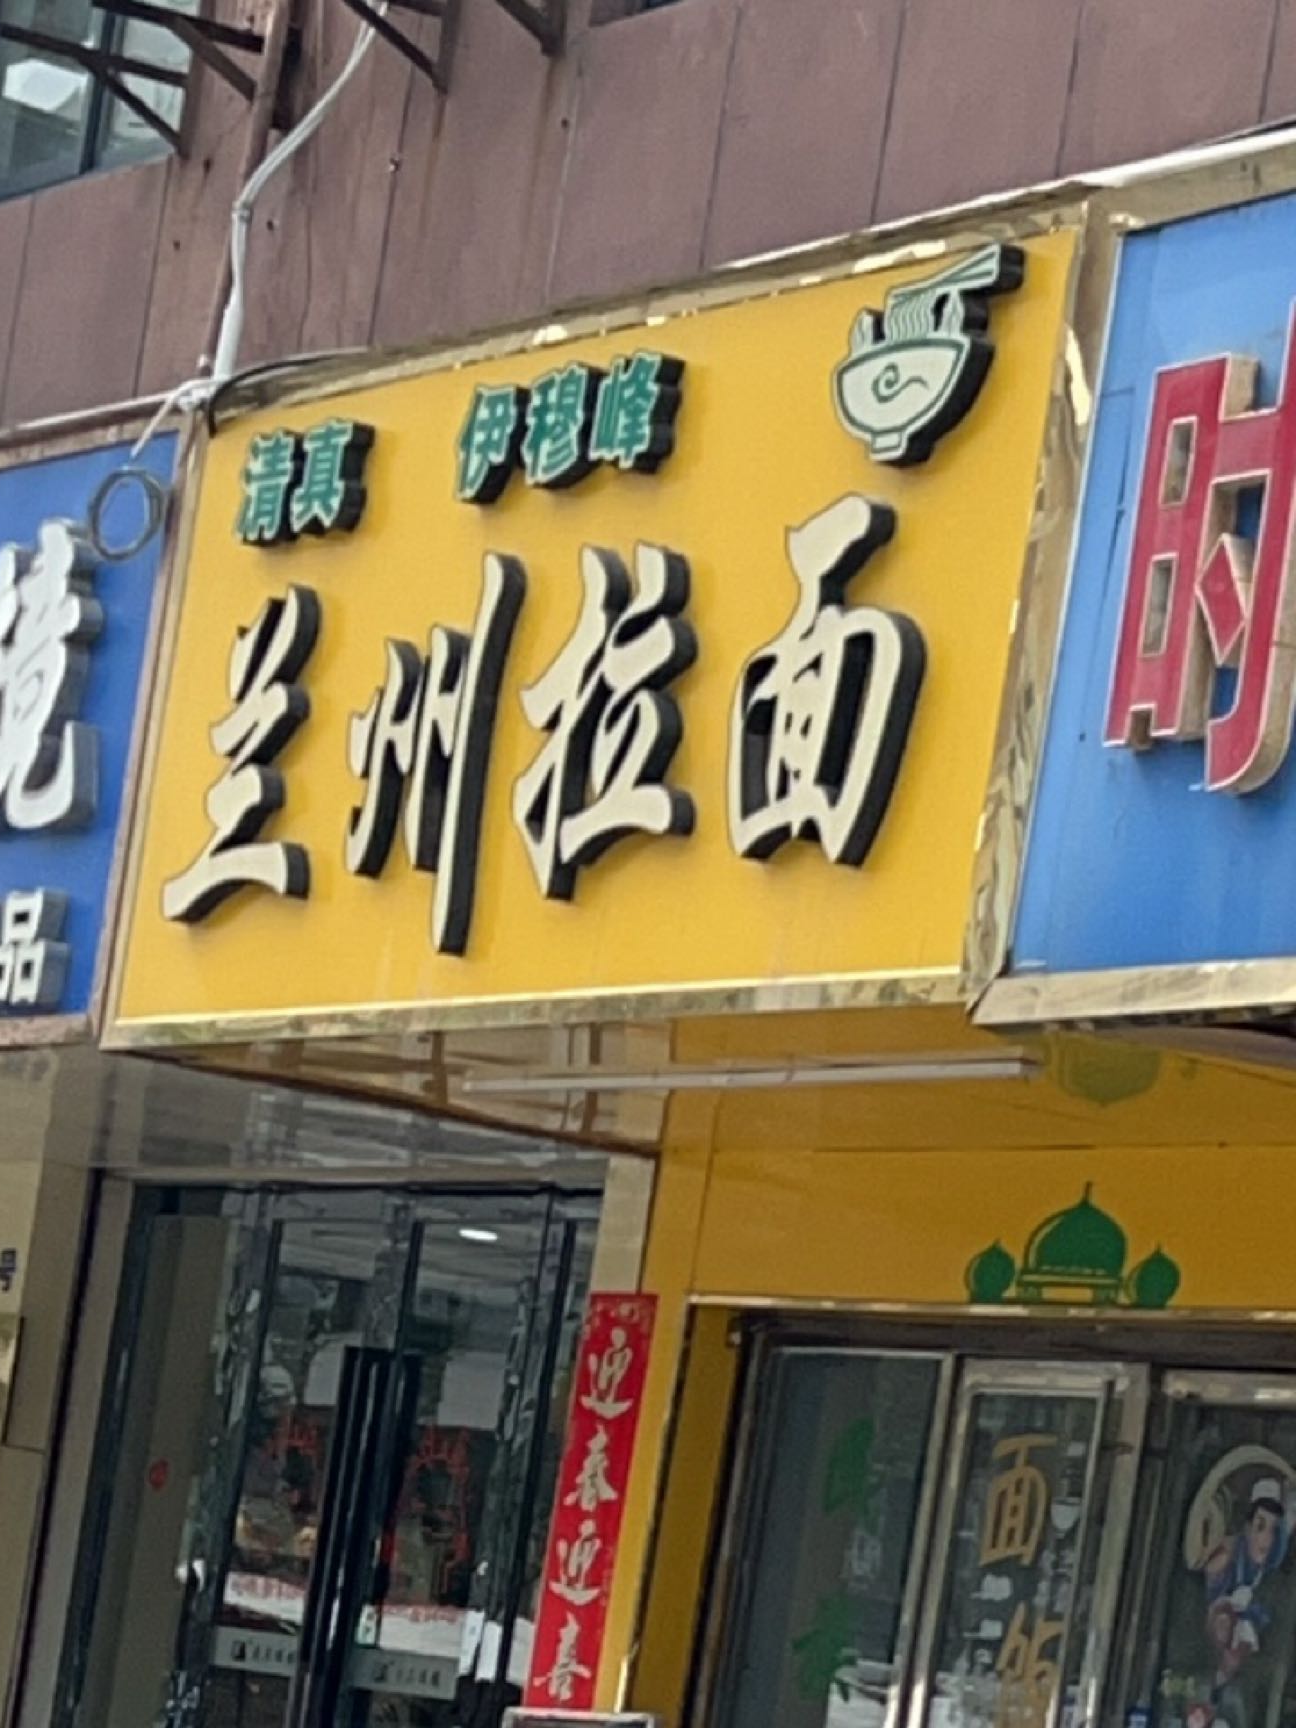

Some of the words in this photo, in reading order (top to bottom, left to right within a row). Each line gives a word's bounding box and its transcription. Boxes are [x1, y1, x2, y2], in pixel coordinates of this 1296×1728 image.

[236, 416, 356, 541] 清真
[456, 348, 662, 500] 伊穆峰
[161, 492, 912, 955] 兰州拉面
[512, 1326, 634, 1703] 迎春迎喜
